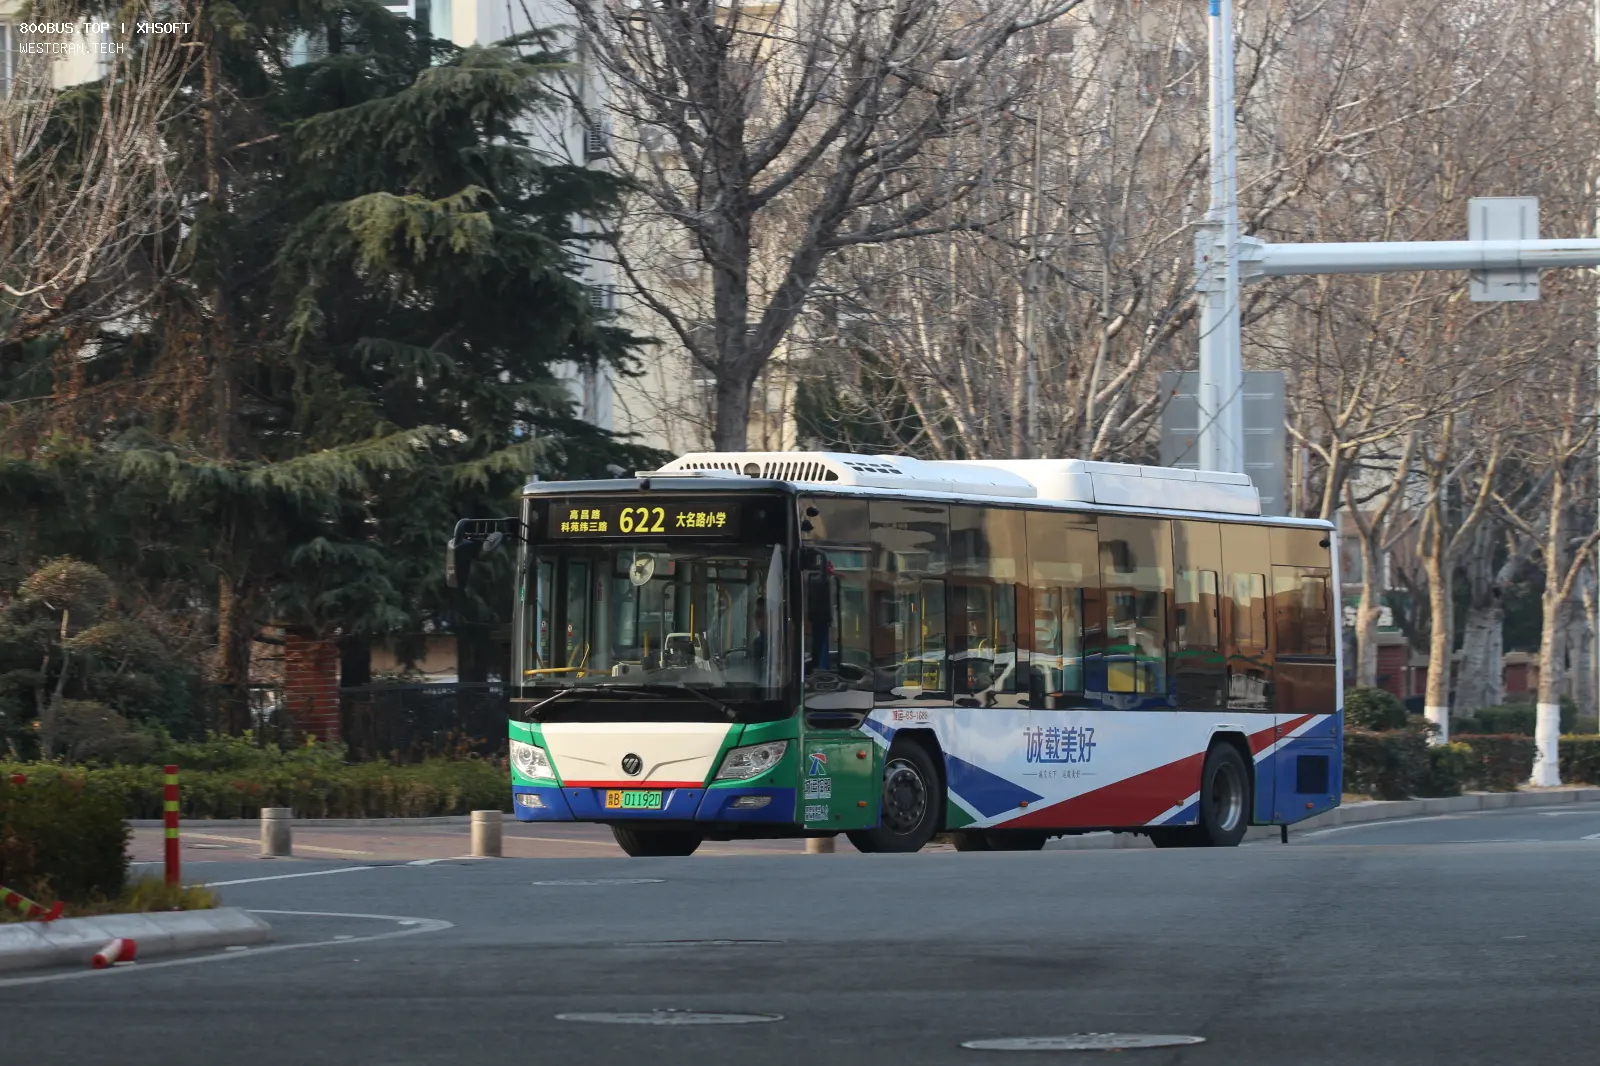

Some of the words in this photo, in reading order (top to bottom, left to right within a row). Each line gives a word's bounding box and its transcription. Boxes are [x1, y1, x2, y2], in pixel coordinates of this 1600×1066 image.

[560, 521, 608, 533] 科苑纬三路
[619, 507, 665, 533] 622
[675, 511, 727, 528] 大名路小学
[1023, 725, 1097, 764] 诚载美好
